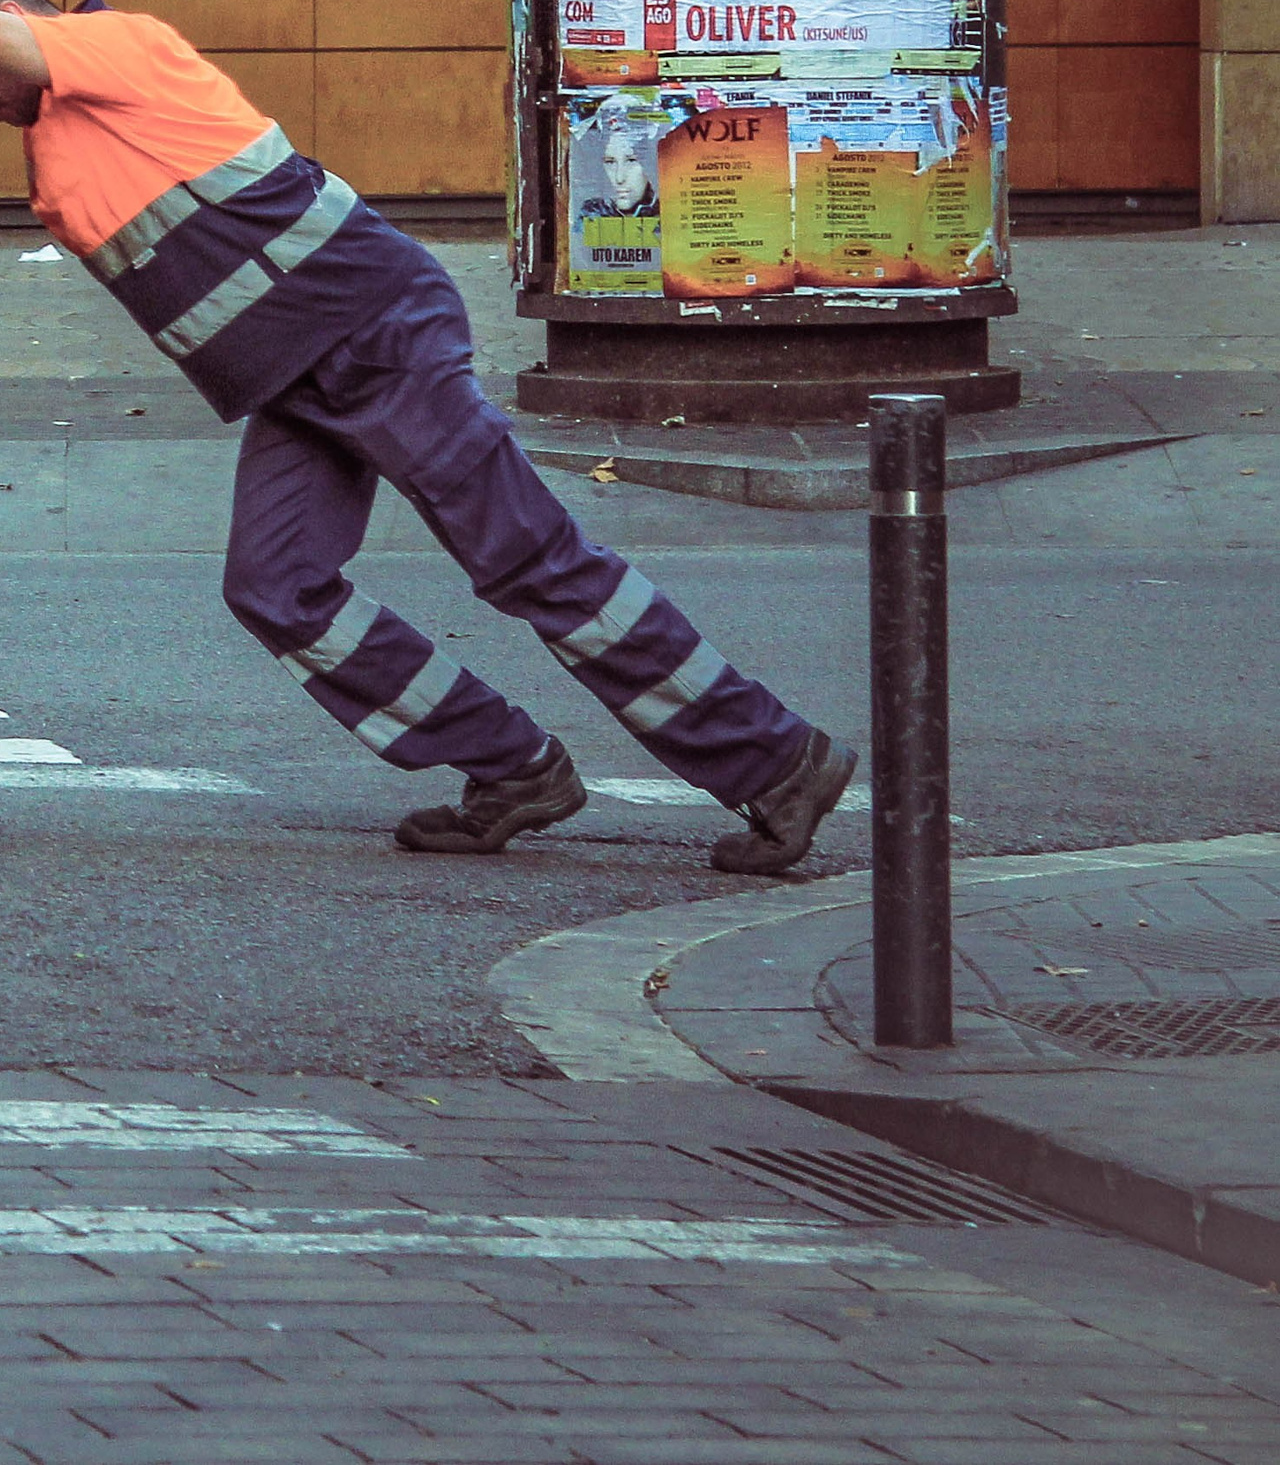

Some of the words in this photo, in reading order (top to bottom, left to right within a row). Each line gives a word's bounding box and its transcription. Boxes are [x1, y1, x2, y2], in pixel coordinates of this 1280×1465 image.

[565, 1, 593, 22] COM
[646, 7, 672, 24] AGO
[686, 5, 797, 42] OLIVER
[803, 25, 868, 42] (KITSUNÉ/US)
[806, 91, 834, 101] DANIEL
[836, 91, 873, 101] STEFANIK
[832, 153, 867, 162] AGOSTO
[695, 162, 730, 171] AGOSTO
[731, 161, 752, 170] 2012
[592, 248, 612, 262] UTO
[614, 248, 652, 262] KAREM
